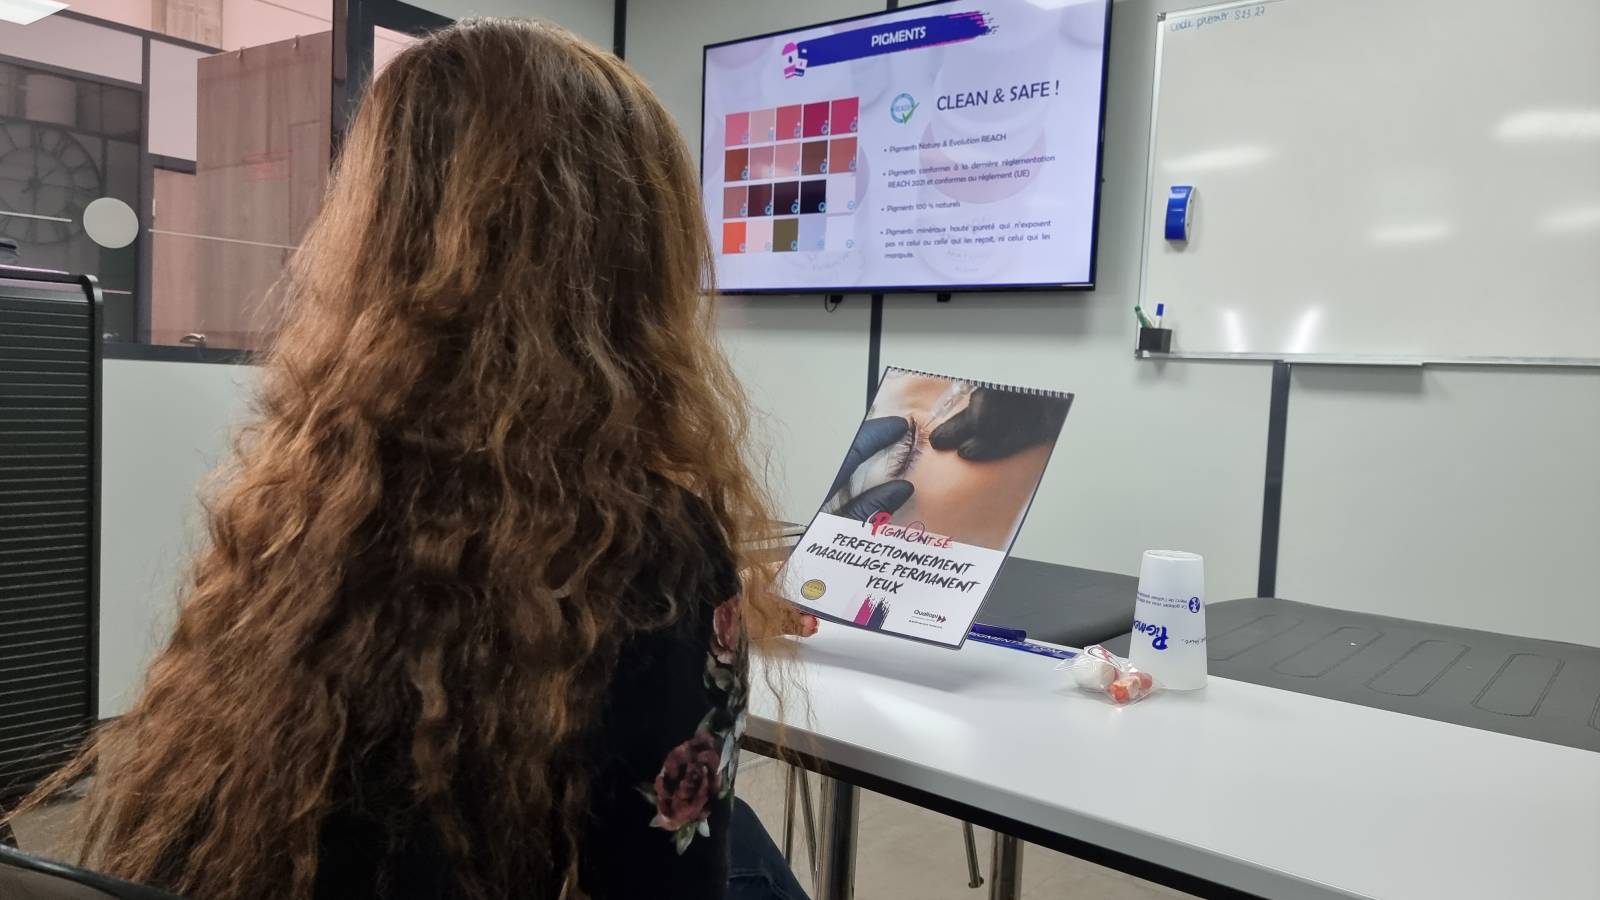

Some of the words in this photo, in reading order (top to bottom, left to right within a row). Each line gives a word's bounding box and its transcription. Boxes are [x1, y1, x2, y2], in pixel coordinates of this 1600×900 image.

[871, 26, 927, 48] PIGMENTS
[937, 89, 988, 111] CLEAN
[992, 87, 1005, 104] &
[1009, 81, 1051, 102] SAFE
[889, 144, 917, 154] Pigments
[918, 142, 941, 150] Nature
[949, 137, 980, 147] Evolution
[981, 133, 1007, 143] REACH
[888, 168, 916, 178] Pigments
[918, 164, 951, 175] conformes
[970, 160, 999, 170] dernière
[888, 180, 911, 188] REACH
[927, 178, 934, 186] et
[934, 175, 967, 185] conformes
[1014, 169, 1030, 179] (UE)
[886, 204, 914, 214] Pigments
[916, 202, 927, 210] 100
[935, 200, 960, 209] naturels
[885, 228, 914, 236] Pigments
[950, 224, 969, 232] haute
[998, 222, 1010, 230] qui
[950, 236, 962, 246] qui
[1007, 232, 1024, 242] celui
[1026, 232, 1038, 242] qui
[832, 533, 976, 575] PERFECTIONNEMENT
[806, 543, 891, 573] MAQUILLAGE
[892, 563, 980, 594] PERMANENT
[866, 575, 904, 594] YEUX
